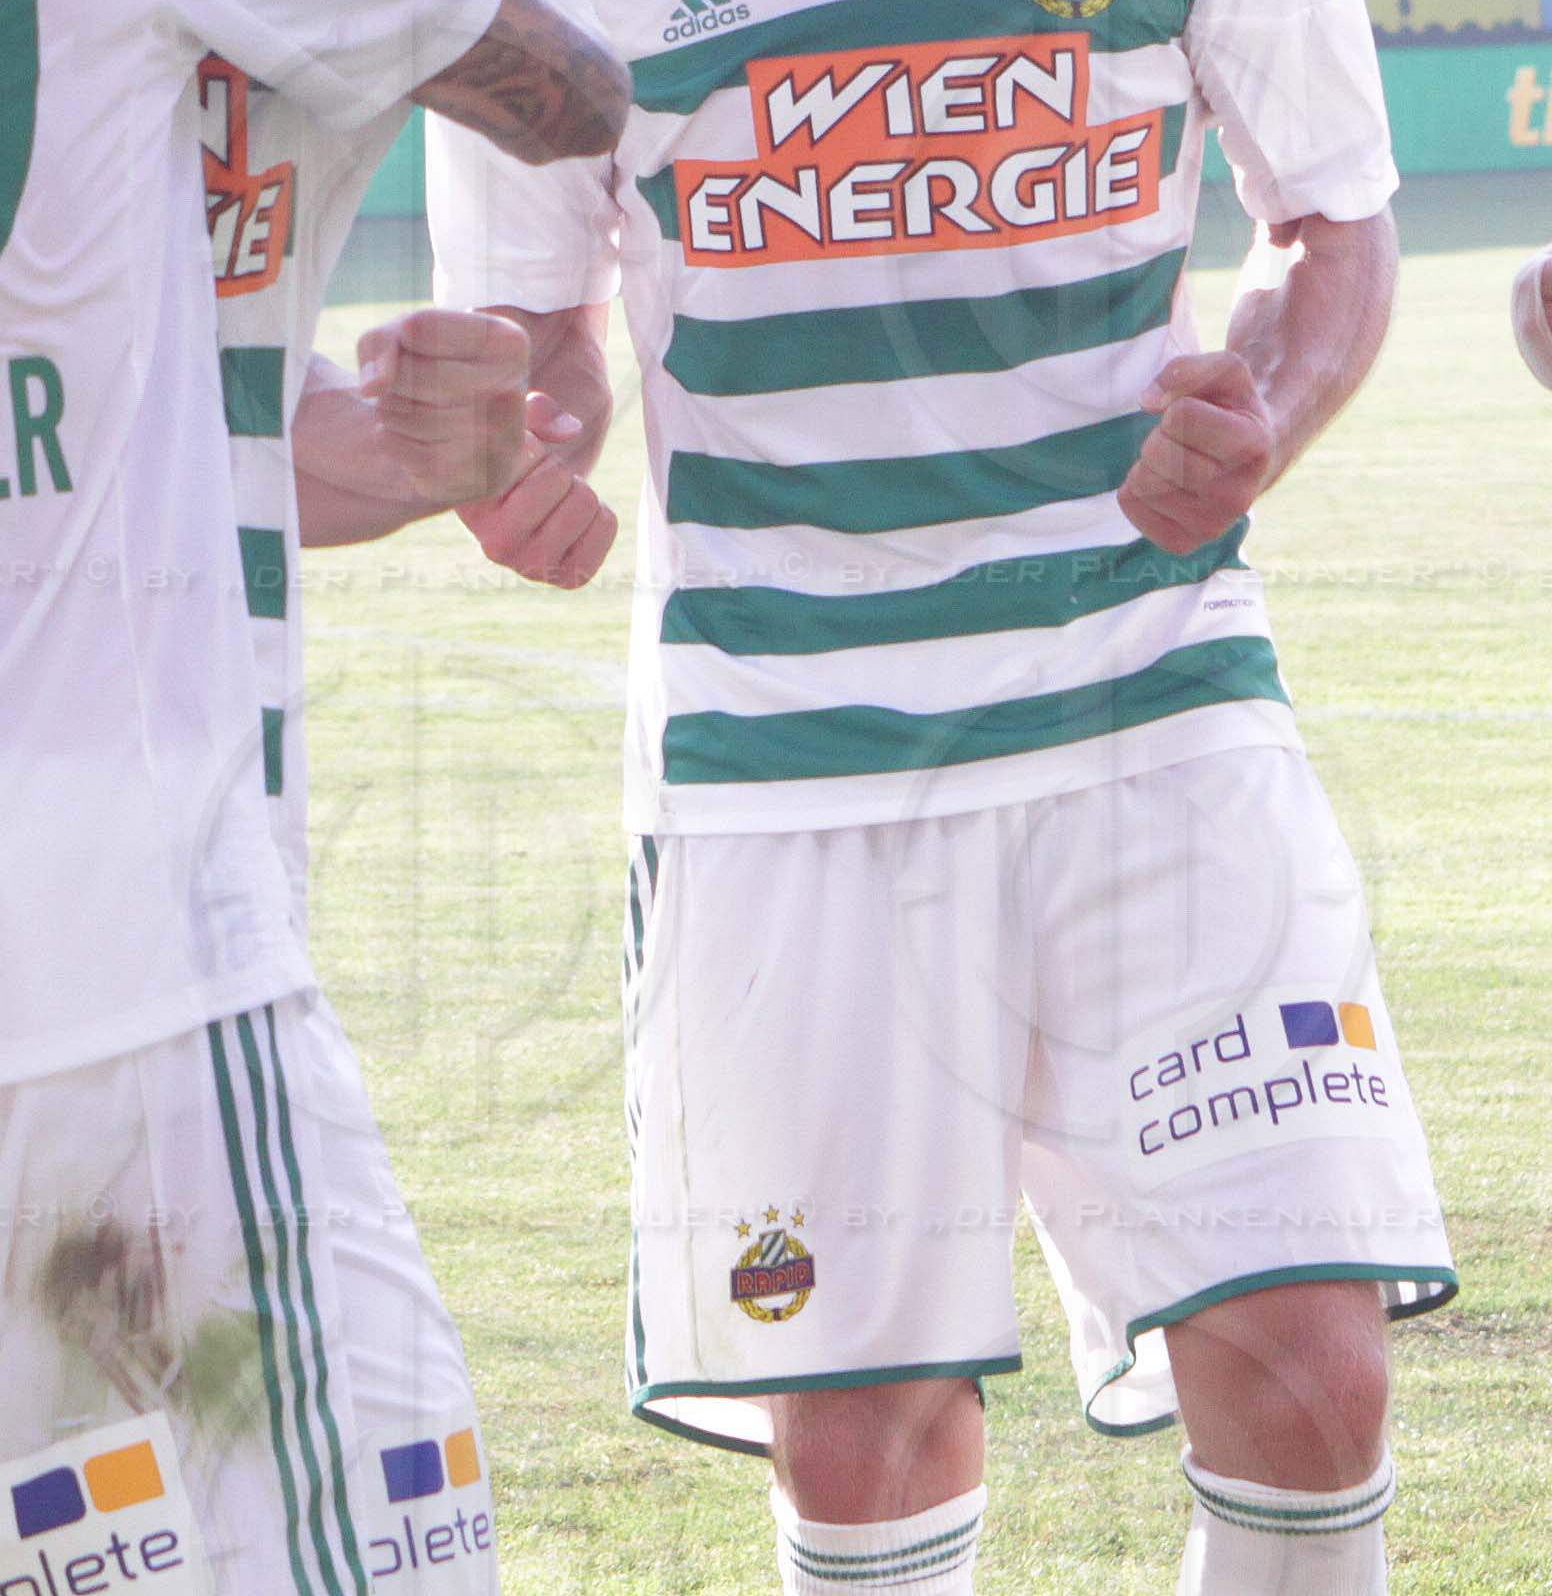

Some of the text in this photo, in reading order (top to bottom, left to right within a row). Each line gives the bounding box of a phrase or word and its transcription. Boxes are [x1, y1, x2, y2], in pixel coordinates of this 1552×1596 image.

[662, 4, 751, 44] adidas
[764, 49, 1076, 152] WIEN
[687, 123, 1154, 254] ENERGIE
[1129, 1013, 1252, 1102] card
[1137, 1060, 1389, 1156] complete
[735, 1261, 810, 1297] RAPID
